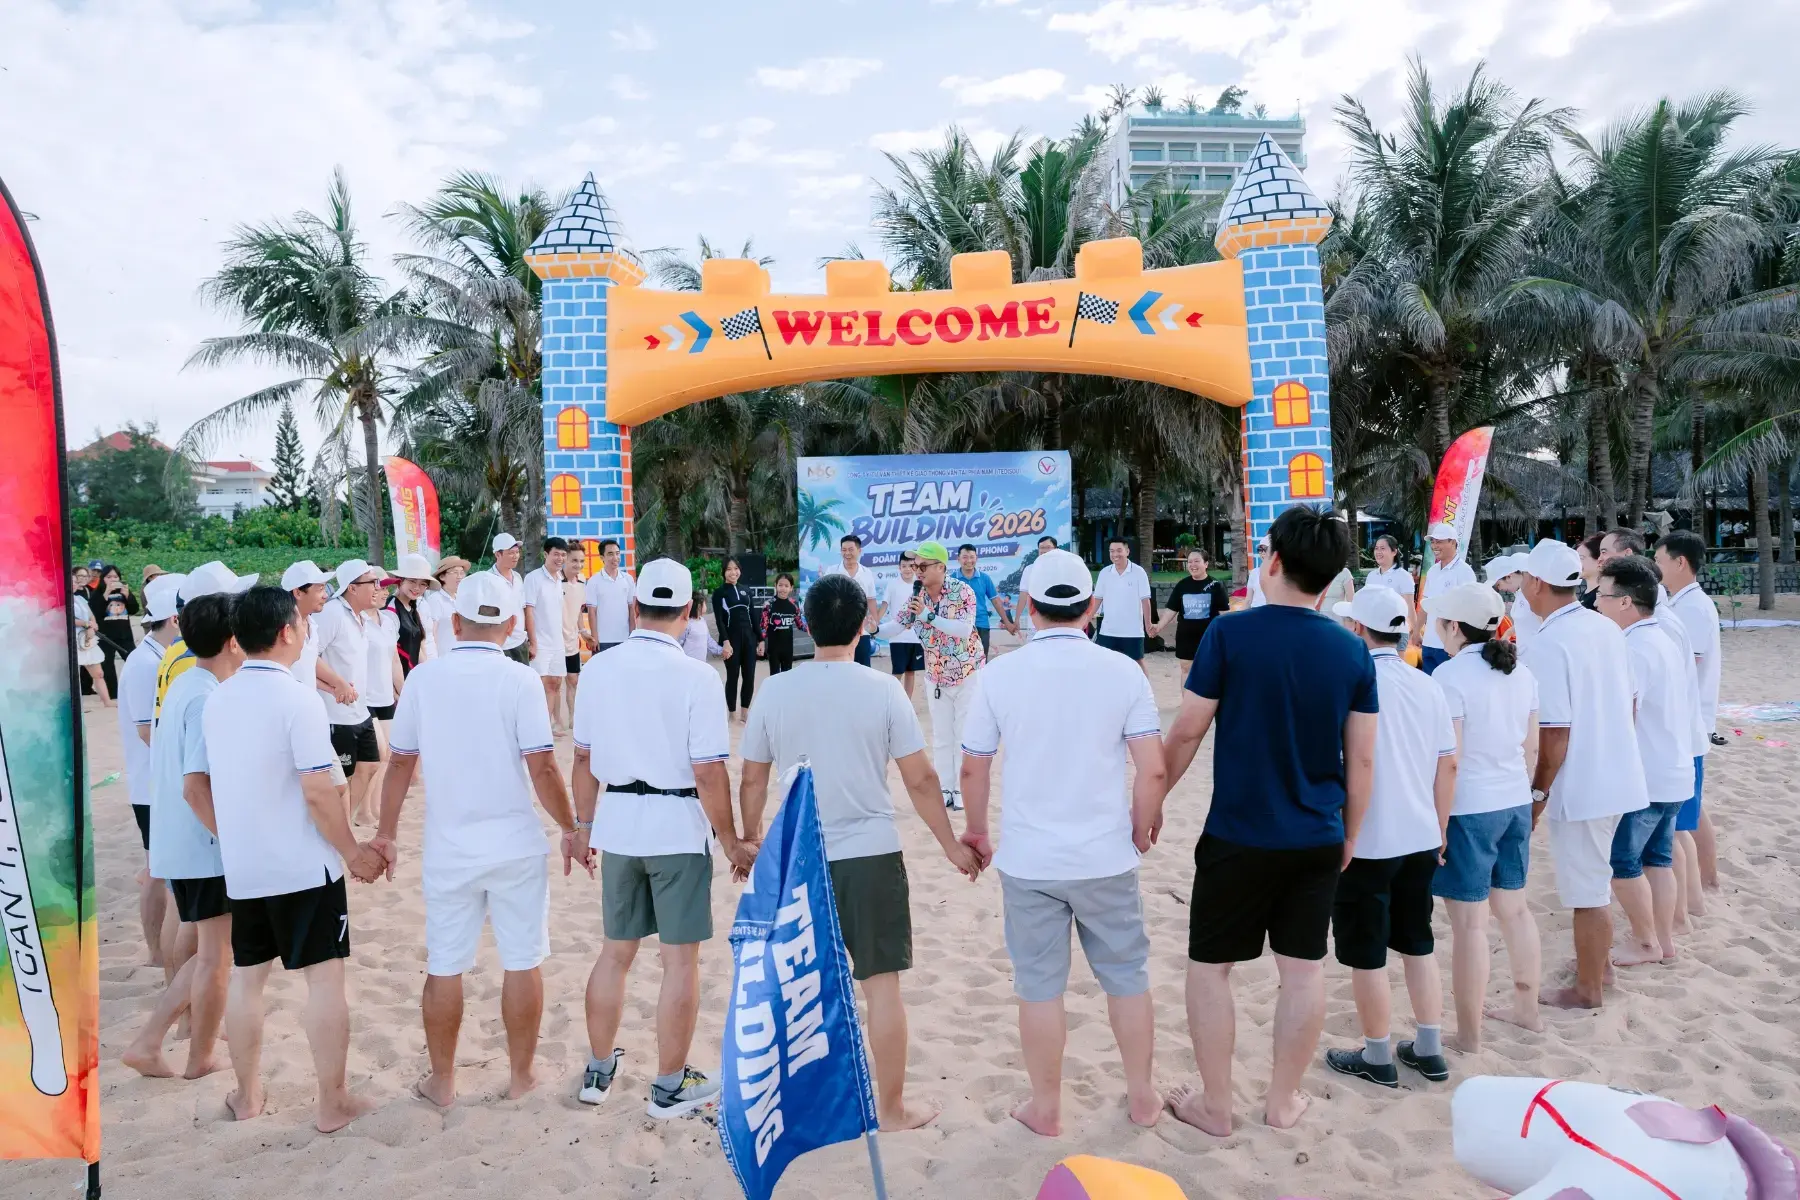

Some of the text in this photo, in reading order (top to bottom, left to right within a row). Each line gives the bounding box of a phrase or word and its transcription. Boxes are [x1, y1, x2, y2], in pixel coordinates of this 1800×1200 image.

[771, 297, 1060, 347] WELCOME
[401, 487, 418, 554] ILDING
[868, 480, 973, 517] TEAM
[851, 508, 1047, 548] BUILDING 2026
[980, 546, 1009, 555] PHONG
[872, 554, 896, 564] ĐOÀN
[771, 881, 830, 1078] TEAM
[735, 939, 784, 1168] ILDING
